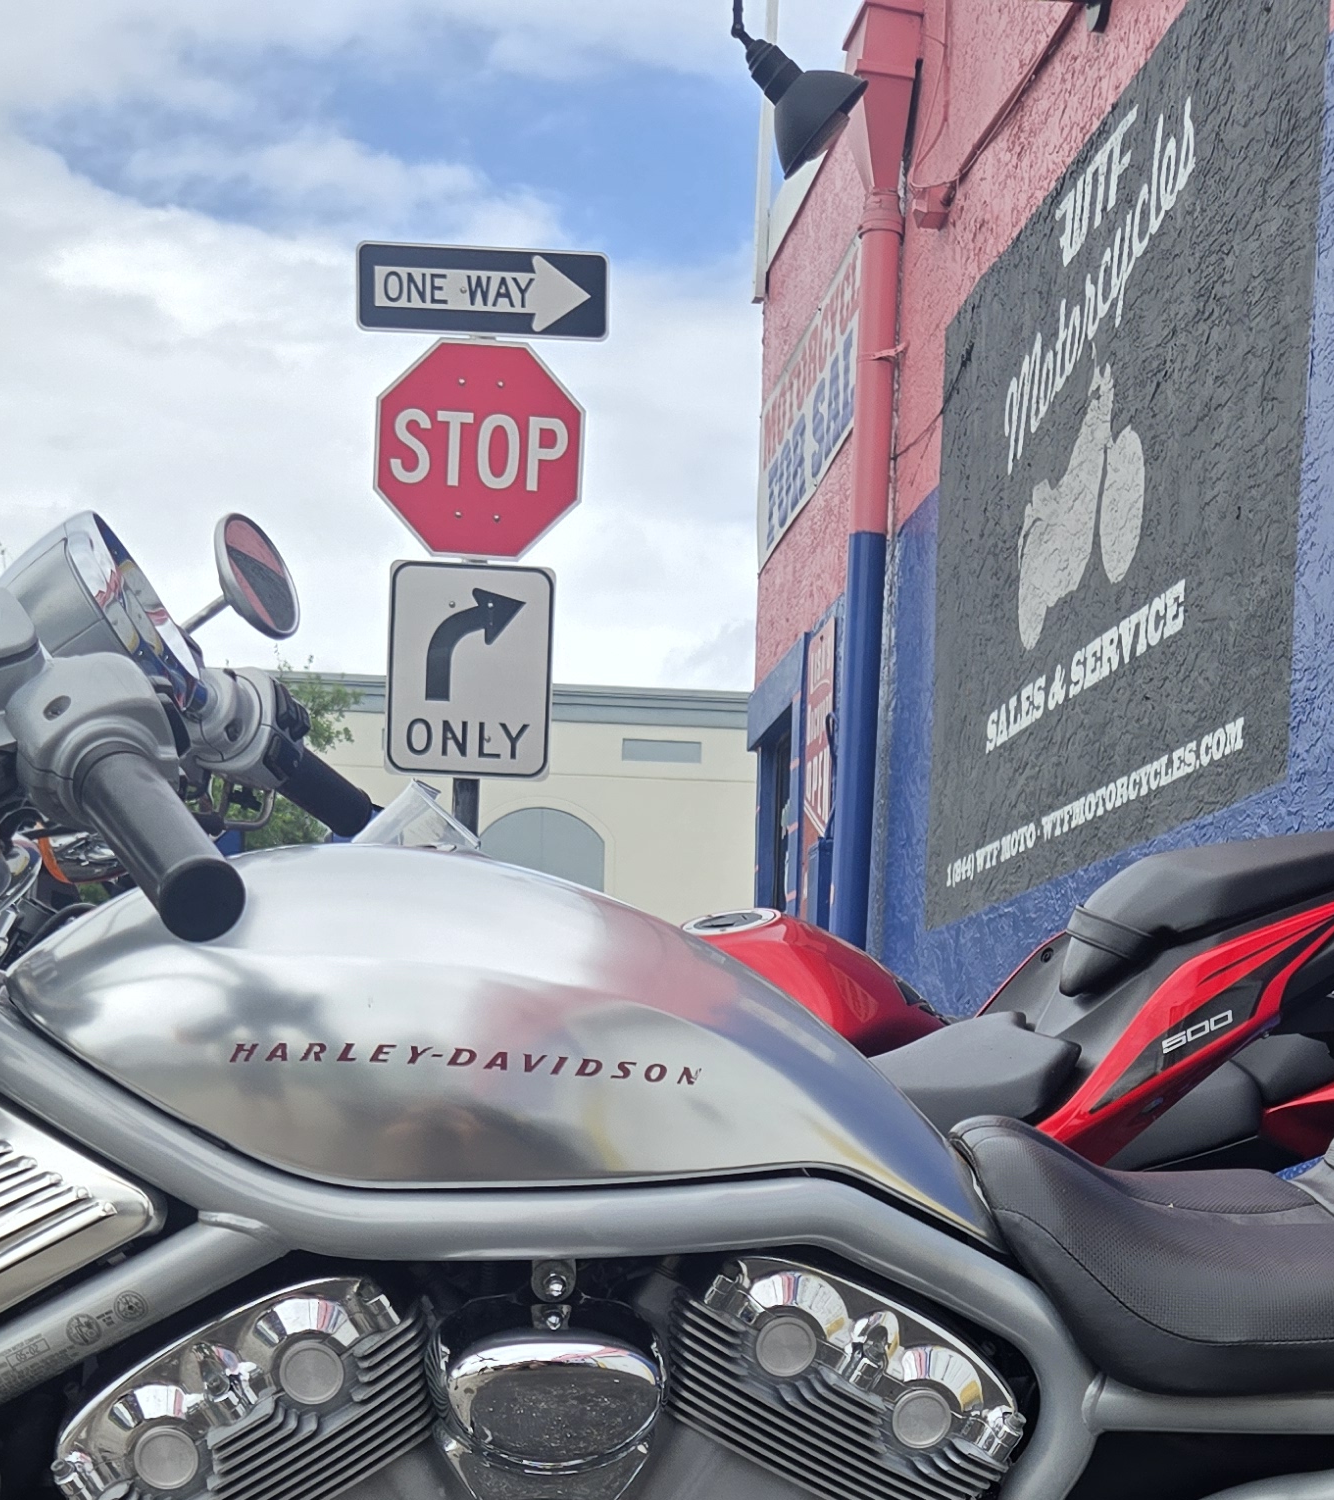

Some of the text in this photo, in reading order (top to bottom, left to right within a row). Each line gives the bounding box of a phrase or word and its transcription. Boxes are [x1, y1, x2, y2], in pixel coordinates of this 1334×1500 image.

[1056, 103, 1140, 268] WTF
[382, 271, 535, 308] ONE WAY
[762, 250, 860, 471] MOTORCYCL
[1004, 96, 1196, 475] Motorcycles
[388, 407, 570, 492] STOP
[766, 328, 855, 552] FOR SAL
[405, 717, 531, 760] ONLY
[985, 578, 1186, 754] SALES & SERVICE
[975, 839, 1001, 873] WTF
[1000, 822, 1037, 863] MOTO
[1040, 716, 1245, 842] WTFMOTORCYCLES.COM
[229, 1041, 704, 1085] HARLEY-DAVIDSON
[1161, 1009, 1234, 1055] 500
